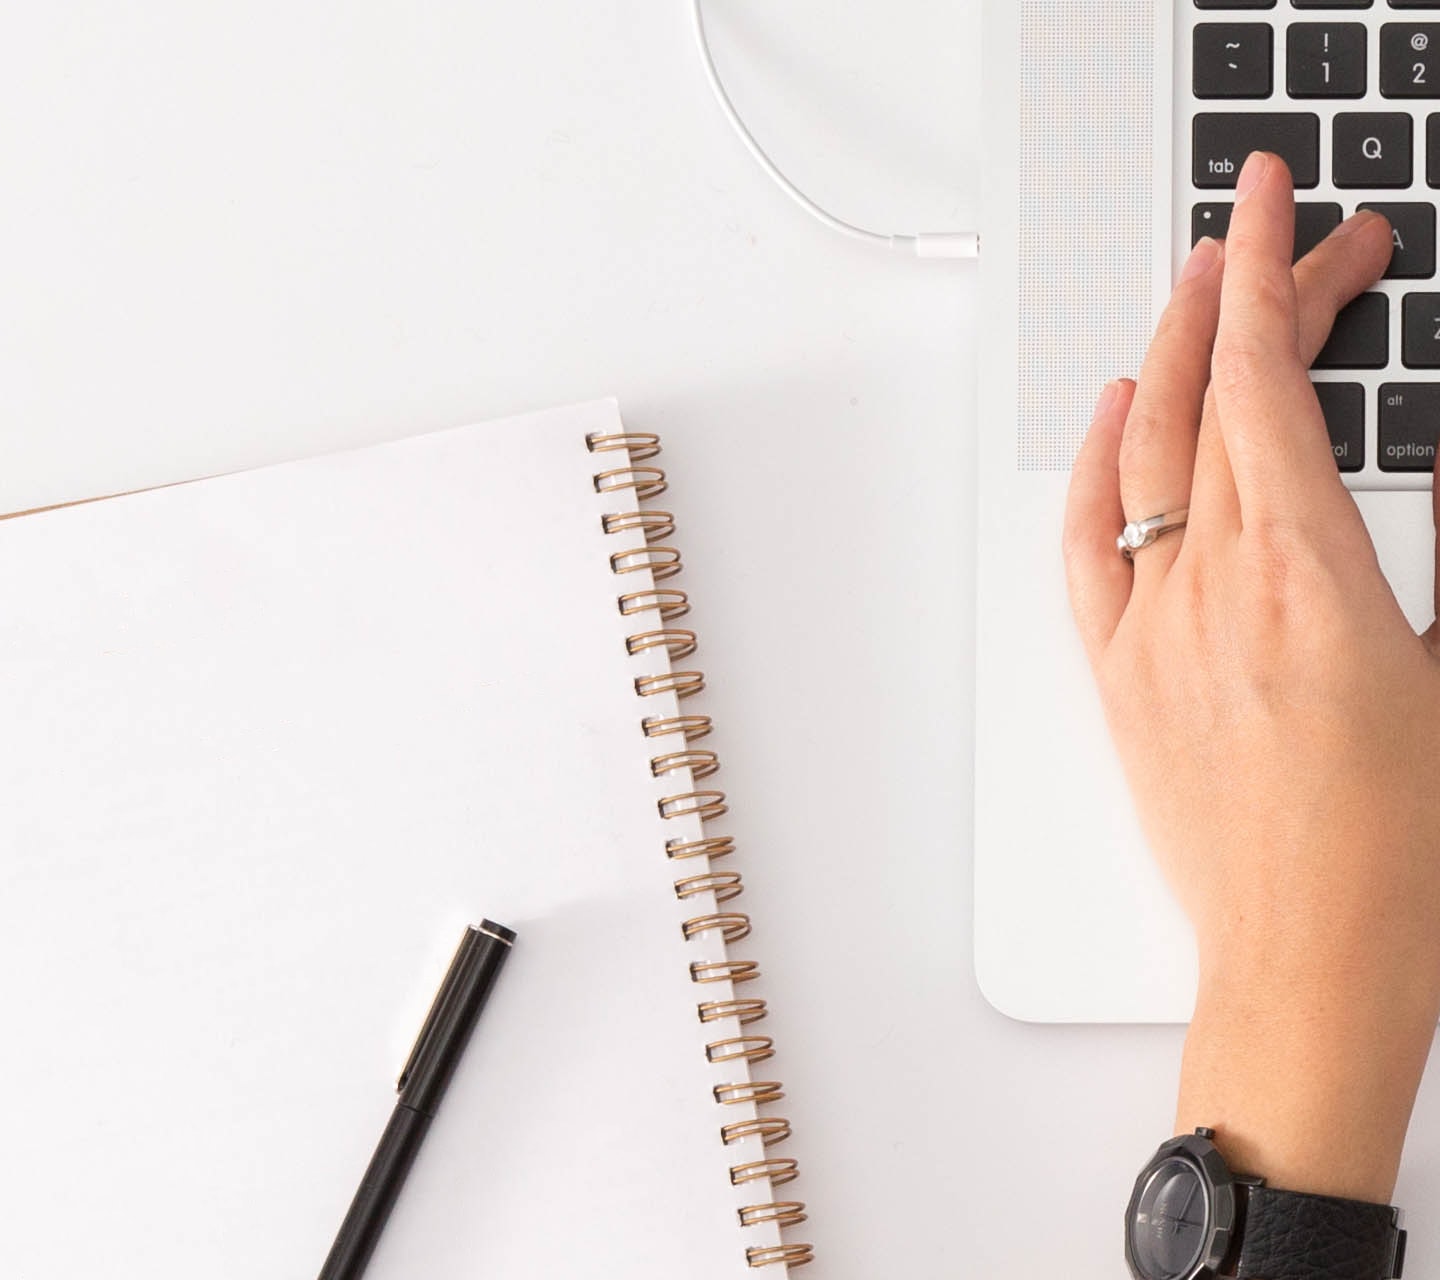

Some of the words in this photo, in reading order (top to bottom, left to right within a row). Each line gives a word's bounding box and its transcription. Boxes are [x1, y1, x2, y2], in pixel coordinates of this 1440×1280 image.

[1323, 32, 1329, 53] !
[1410, 32, 1429, 52] @
[1321, 61, 1330, 83] 1
[1412, 62, 1426, 84] 2
[1361, 136, 1383, 160] Q
[1208, 157, 1235, 174] tab
[1387, 394, 1403, 406] alt
[1386, 443, 1434, 459] option
